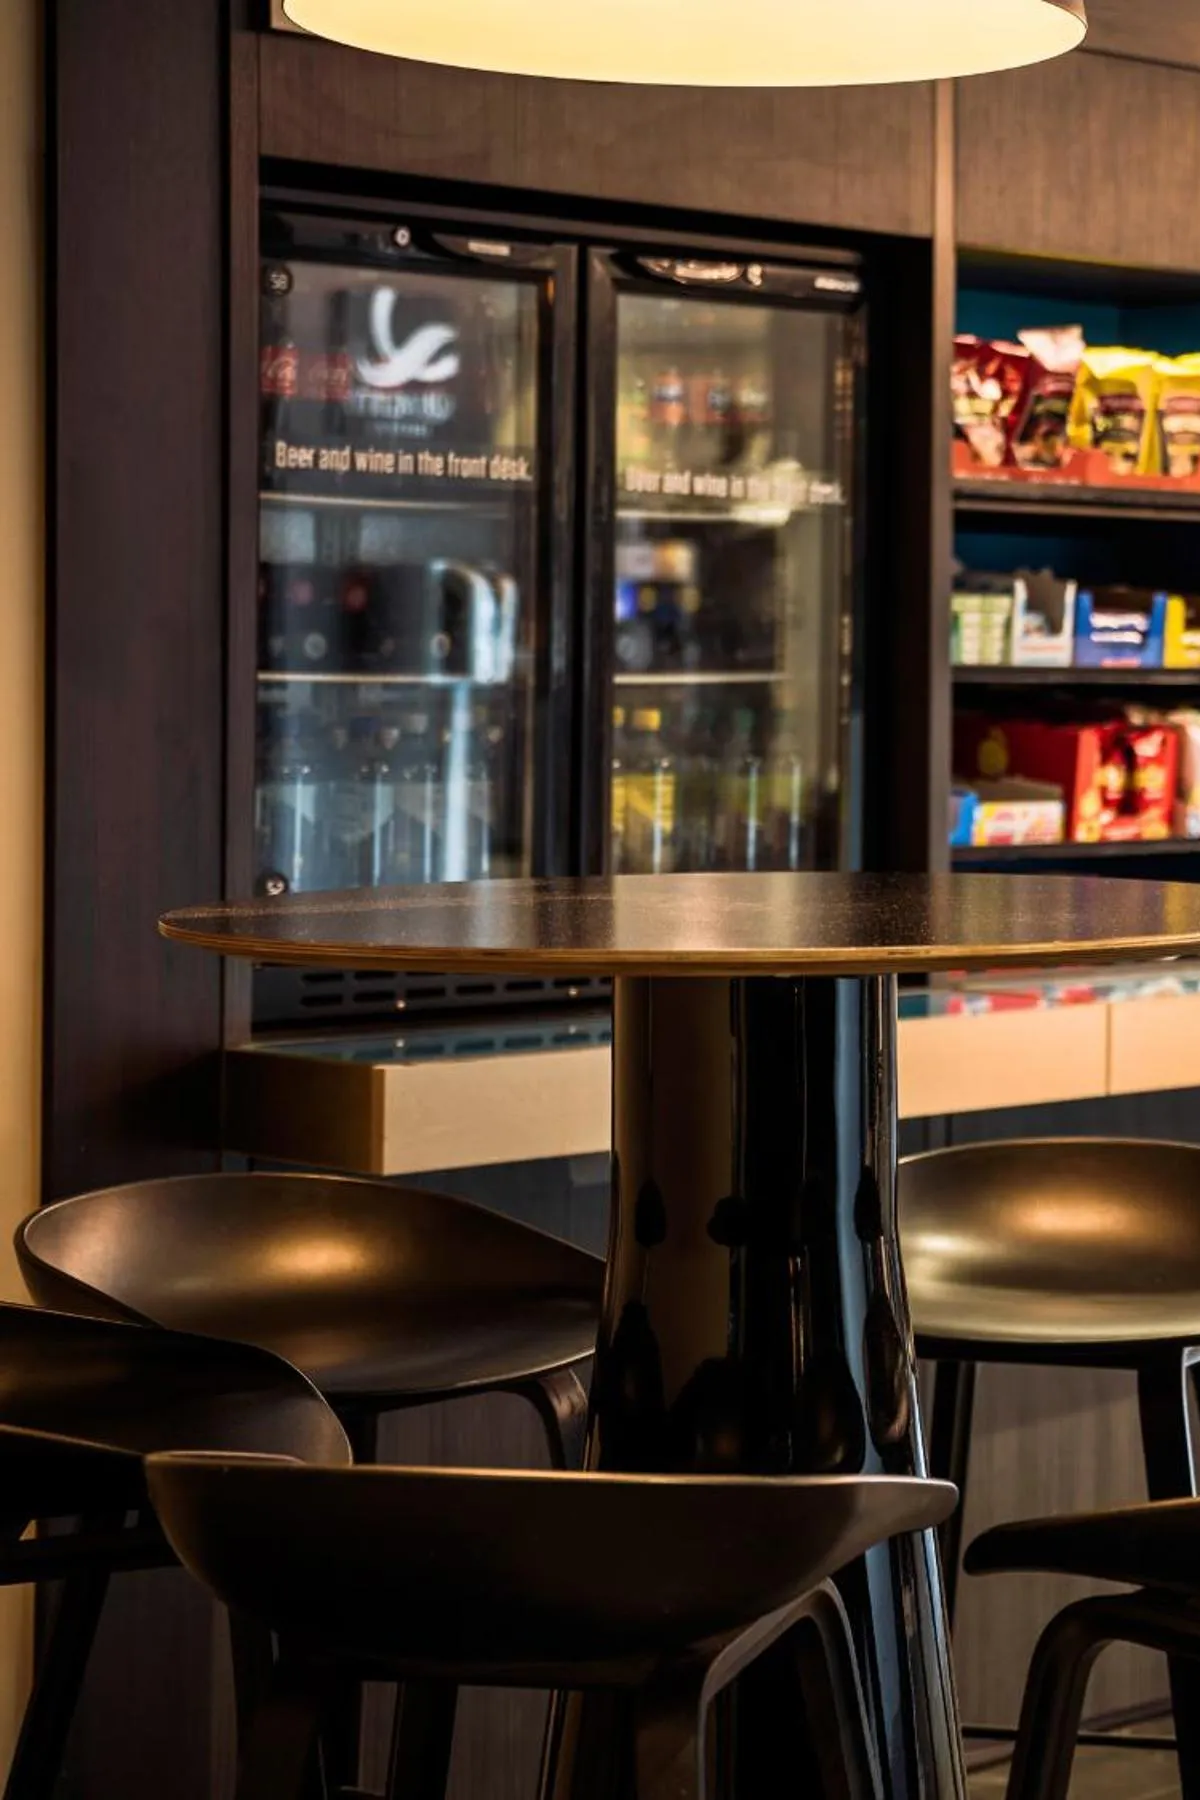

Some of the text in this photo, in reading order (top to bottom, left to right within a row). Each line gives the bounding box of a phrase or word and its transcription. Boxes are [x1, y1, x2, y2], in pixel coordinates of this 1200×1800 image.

[275, 440, 533, 481] Beer and wine in the front desk.
